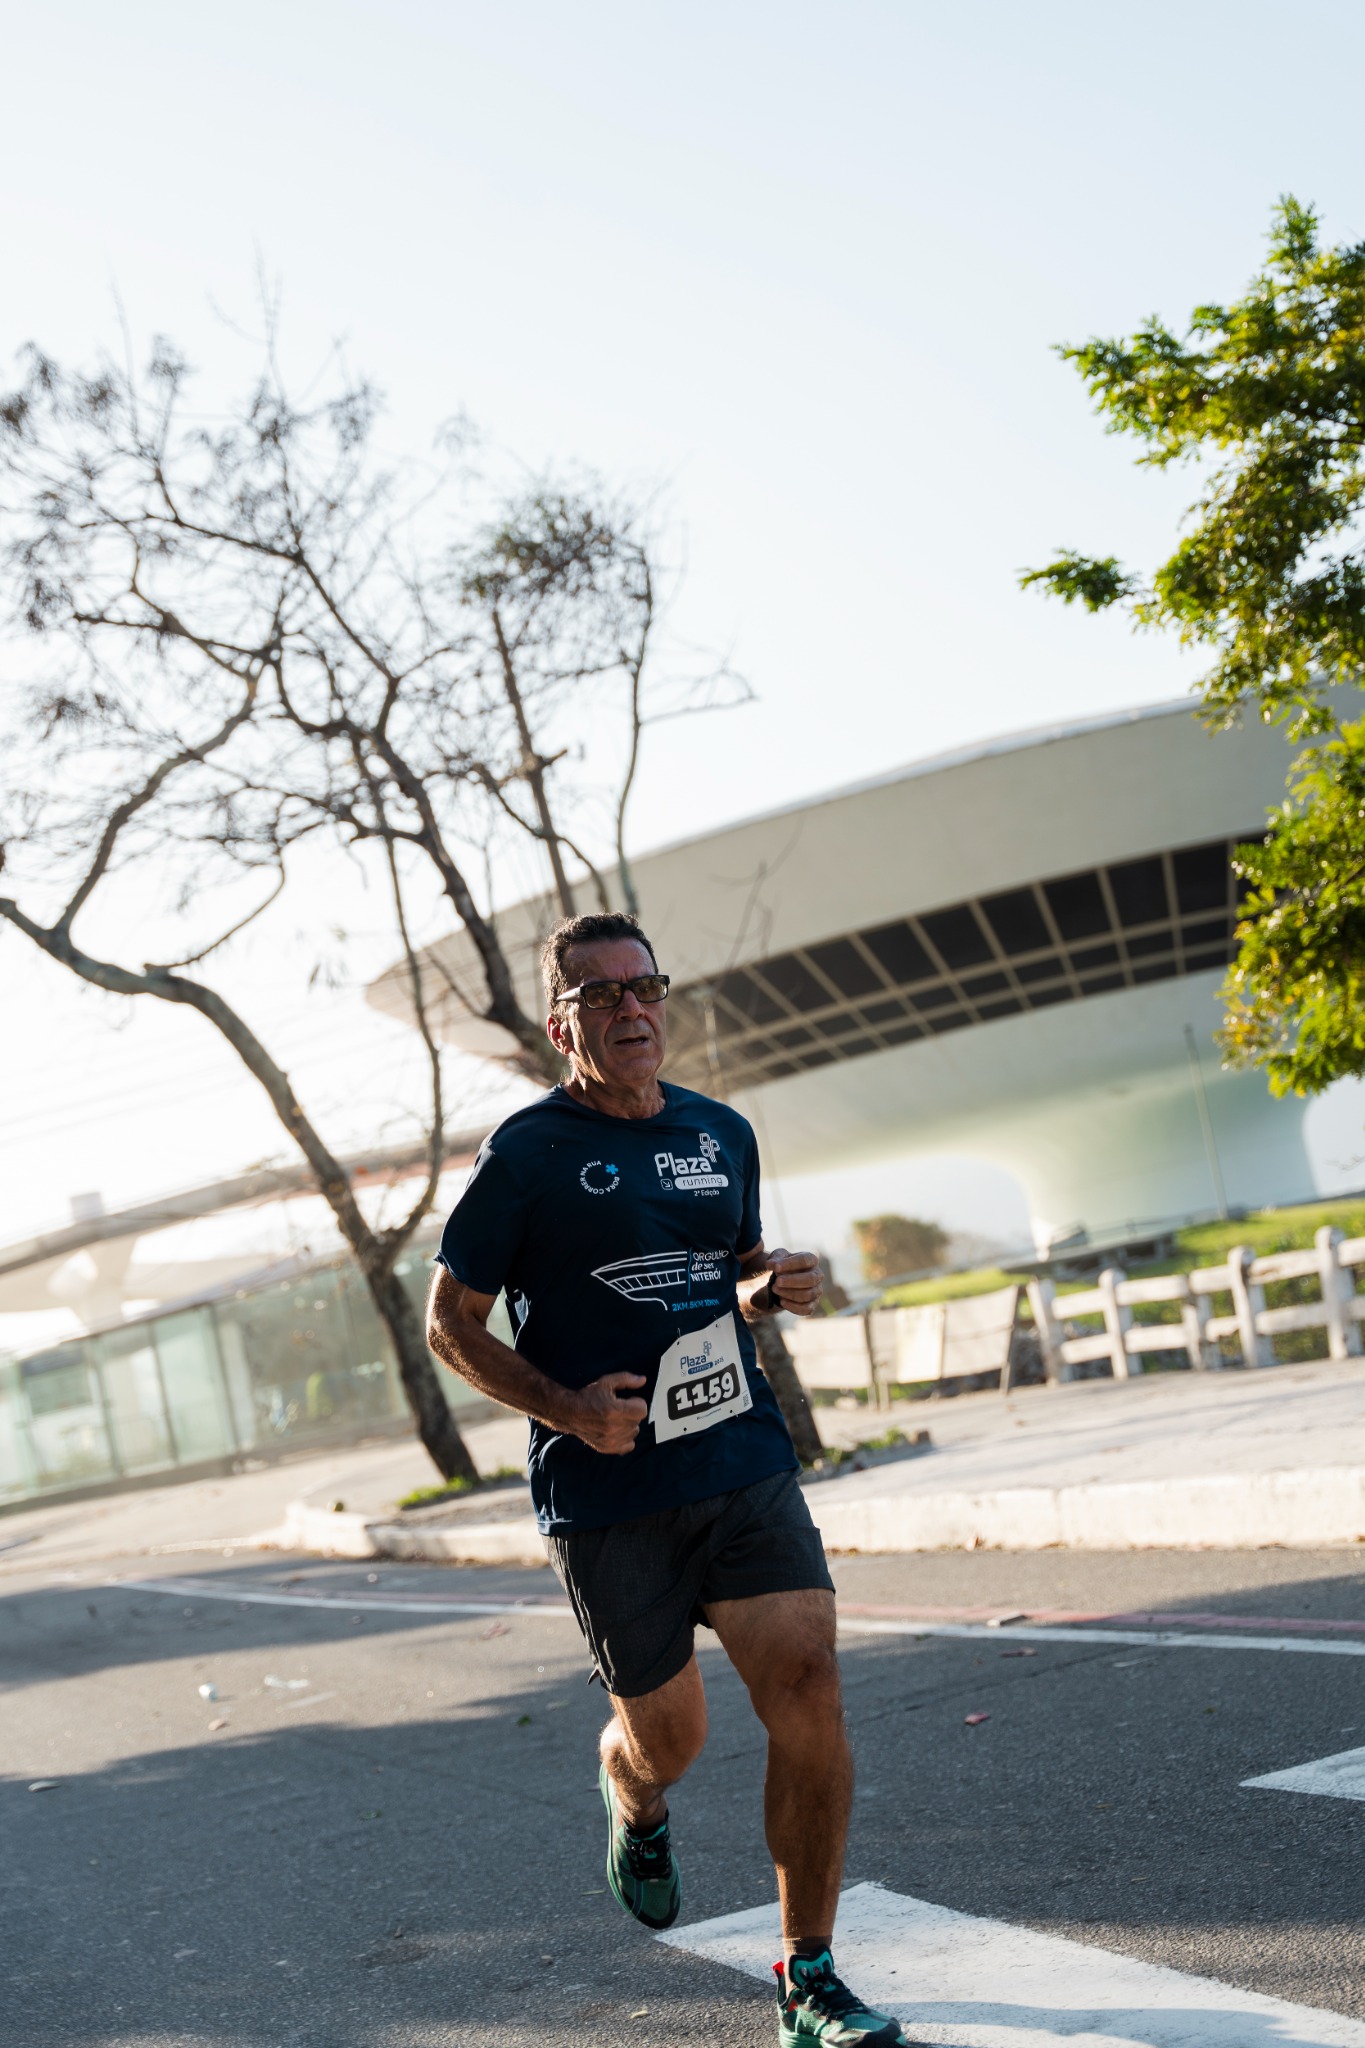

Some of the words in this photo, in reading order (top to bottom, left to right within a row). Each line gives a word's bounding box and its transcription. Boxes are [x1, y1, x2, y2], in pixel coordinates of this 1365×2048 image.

[586, 1160, 602, 1168] RUA
[654, 1152, 713, 1177] Plaza
[580, 1167, 588, 1176] NA
[580, 1177, 605, 1194] CORRER
[682, 1175, 723, 1187] running
[692, 1249, 729, 1262] ORGULHO
[691, 1262, 703, 1271] de
[703, 1262, 714, 1270] ser
[690, 1268, 721, 1281] NITERÓI
[680, 1354, 707, 1370] Plaza
[675, 1371, 735, 1411] 1159
